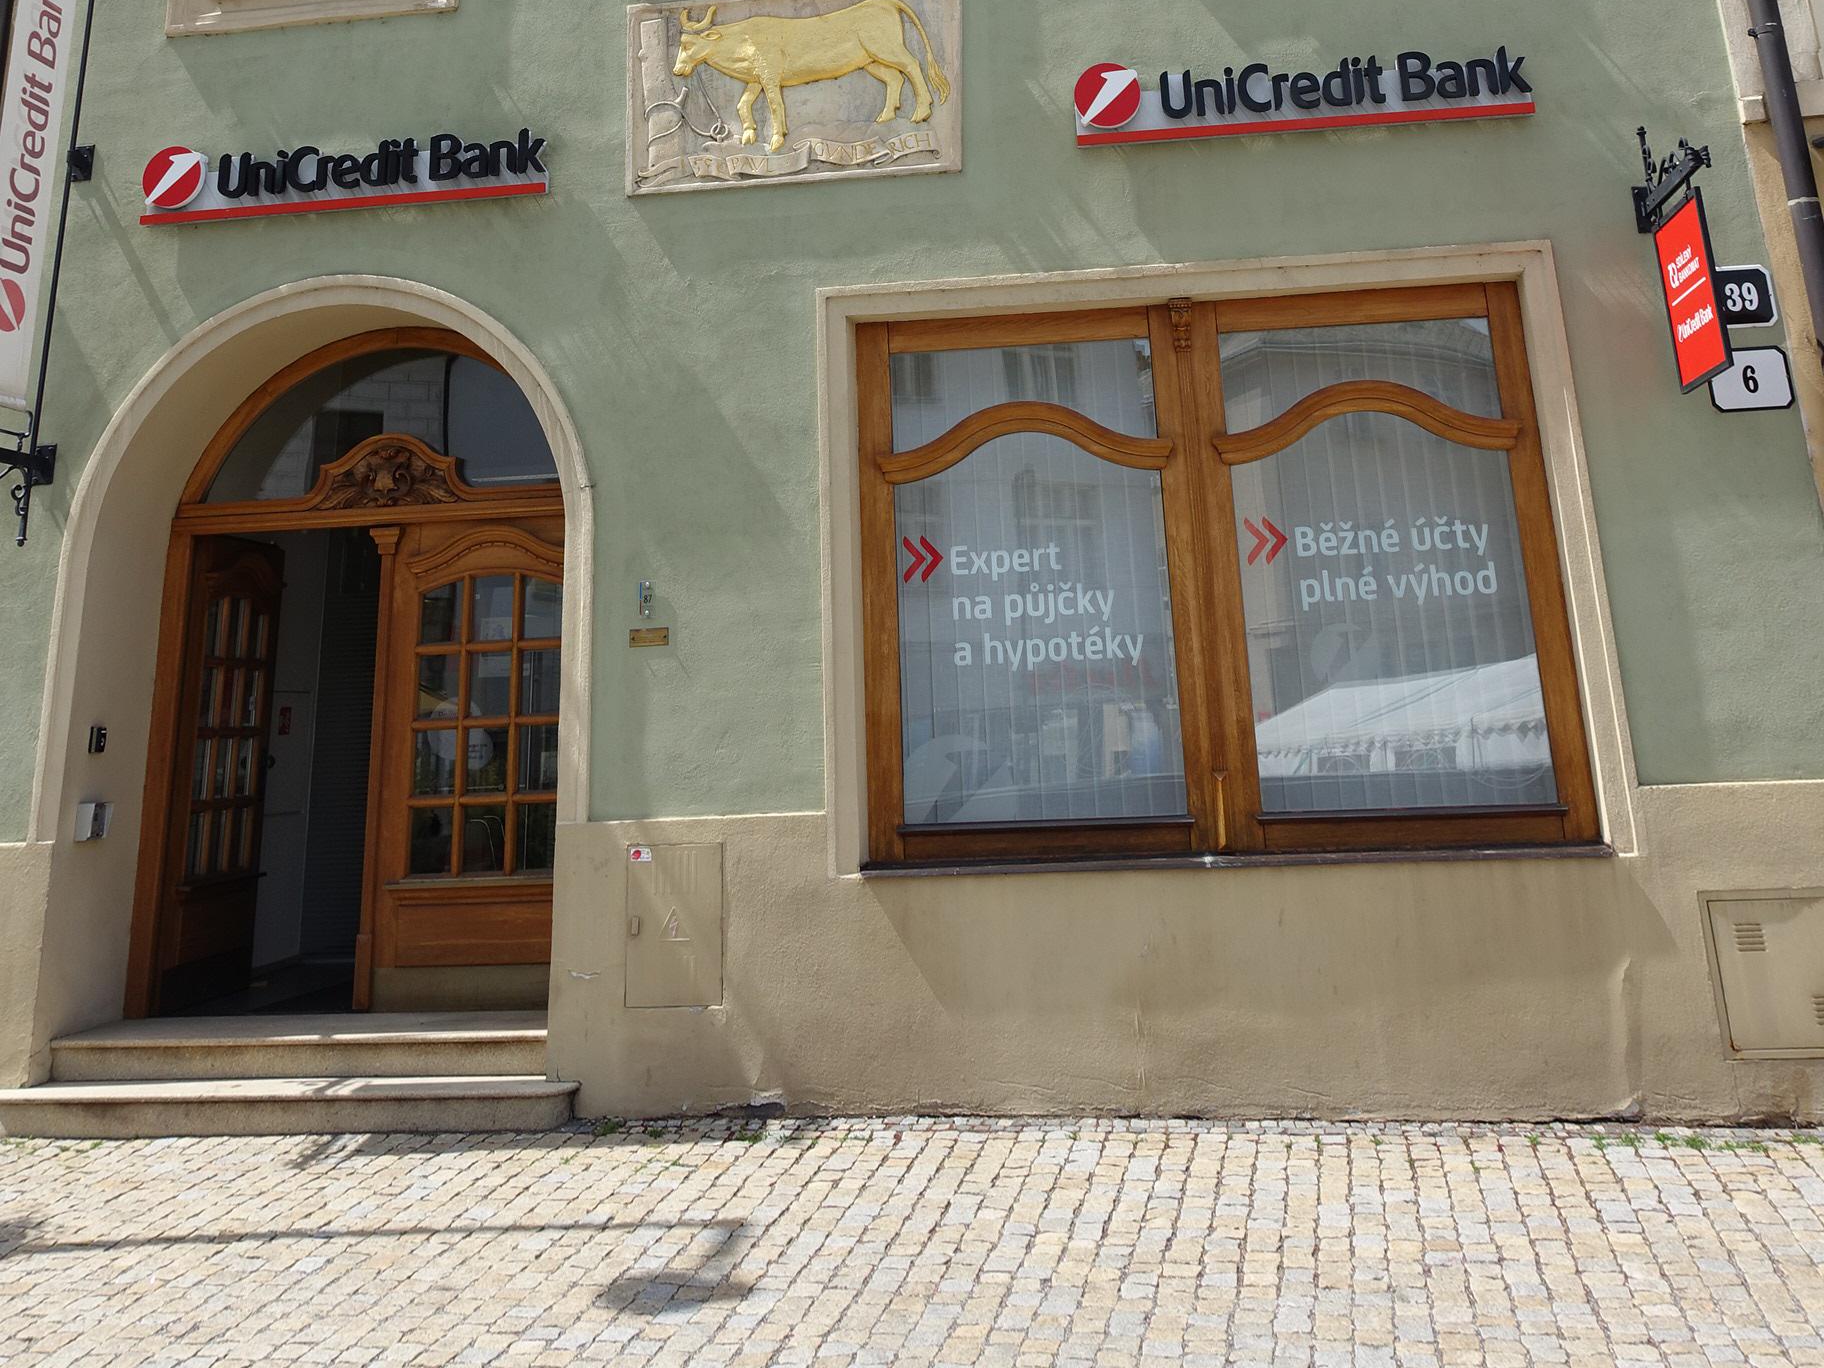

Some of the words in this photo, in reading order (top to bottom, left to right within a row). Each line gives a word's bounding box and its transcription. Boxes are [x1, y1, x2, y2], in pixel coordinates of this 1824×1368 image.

[1159, 54, 1386, 119] UniCredit
[1396, 45, 1533, 102] Bank
[2, 72, 53, 275] UniCredit
[217, 138, 418, 199] UniCredit
[429, 127, 547, 181] Bank
[1723, 282, 1759, 312] 39
[1742, 365, 1759, 394] 6
[1294, 518, 1400, 557] Běžné
[1411, 515, 1489, 556] účty
[950, 543, 1062, 581] Expert
[952, 594, 992, 620] na
[1004, 582, 1115, 626] půjčky
[1300, 566, 1378, 611] plné
[1387, 561, 1498, 605] výhod
[953, 641, 972, 666] a
[984, 626, 1144, 671] hypotéky
